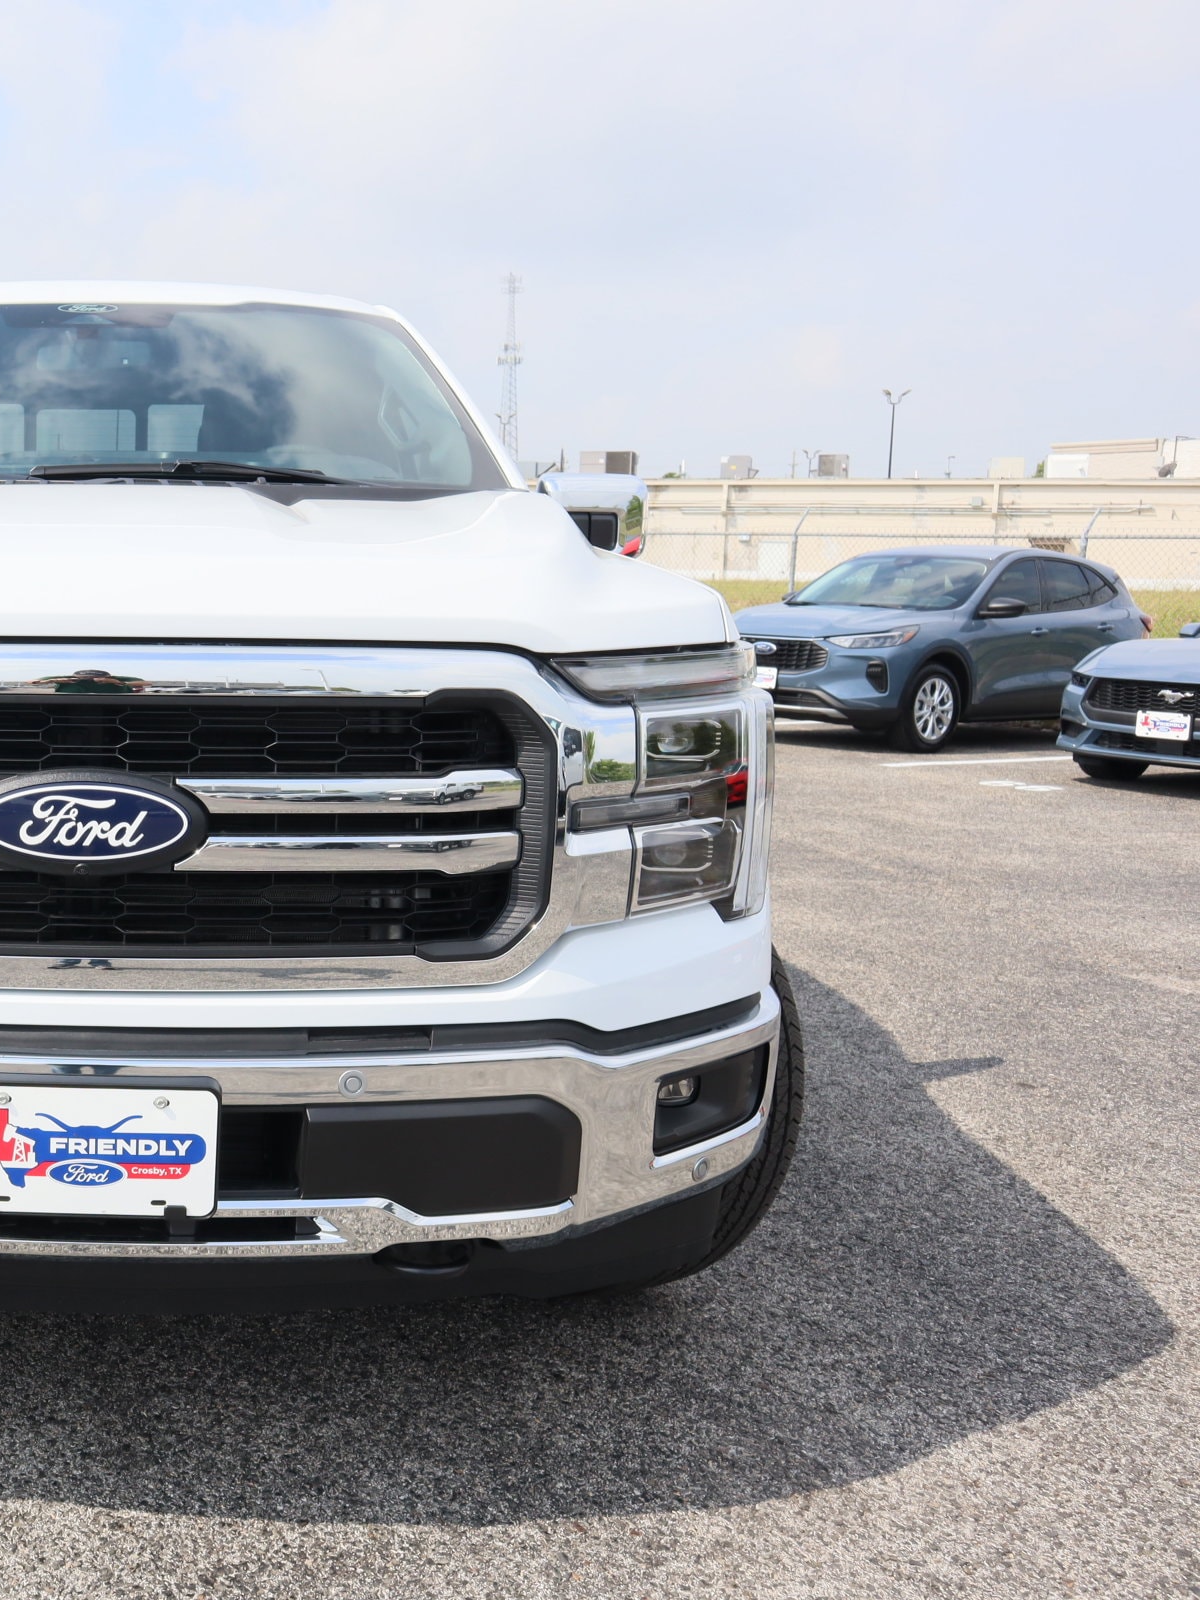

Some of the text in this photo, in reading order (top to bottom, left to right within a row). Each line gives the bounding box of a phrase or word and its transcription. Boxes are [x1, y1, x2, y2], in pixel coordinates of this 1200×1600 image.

[19, 795, 148, 847] Ford
[49, 1137, 193, 1157] FRIENDLY
[64, 1164, 109, 1183] Ford
[131, 1167, 182, 1176] Crosby, TX
